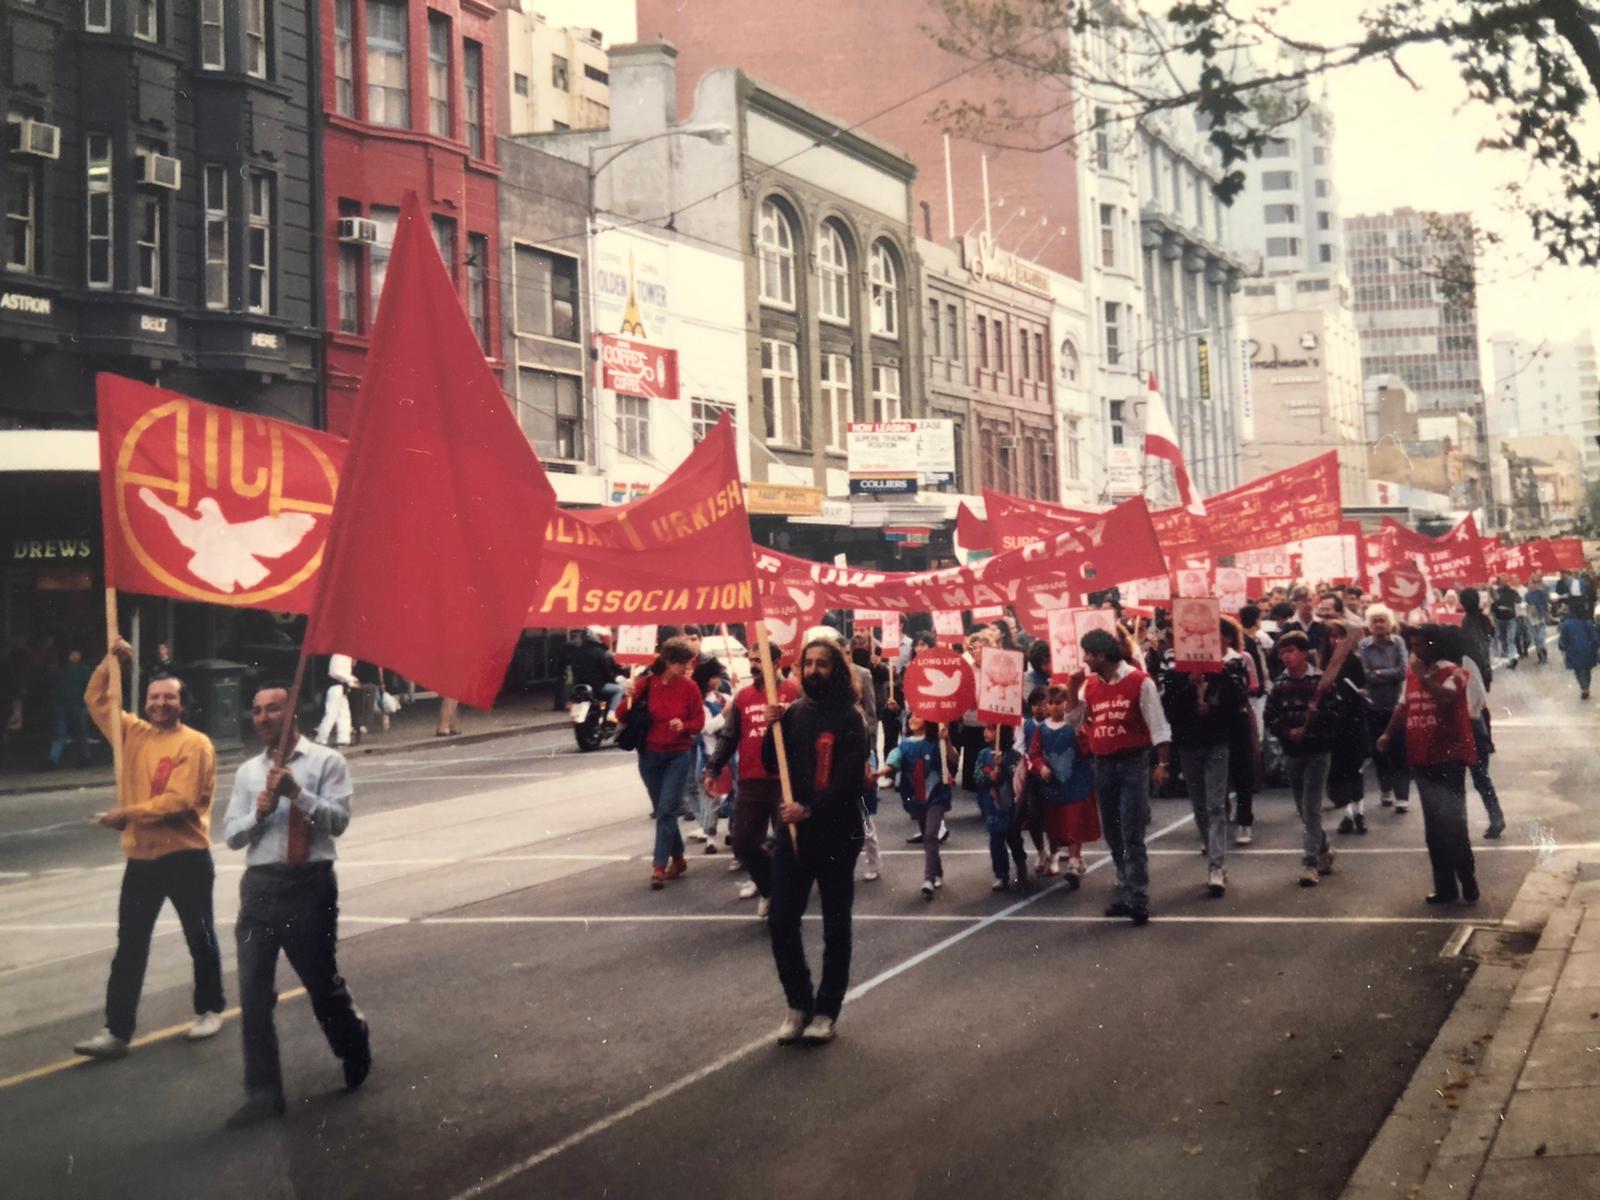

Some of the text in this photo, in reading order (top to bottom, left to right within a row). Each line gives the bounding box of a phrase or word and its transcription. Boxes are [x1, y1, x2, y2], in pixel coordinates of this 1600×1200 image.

[1, 293, 50, 314] ASTRON
[141, 314, 167, 332] BELT
[852, 423, 873, 433] NOW
[860, 480, 908, 489] COLLIERS
[616, 480, 743, 552] TURKISH
[14, 540, 91, 558] DREWS
[540, 559, 754, 614] ASSOCIATION
[1049, 580, 1068, 589] LIVE
[917, 656, 962, 666] LONG LIVE
[919, 701, 957, 710] MAY DAY
[988, 703, 1015, 713] ATCA
[1092, 699, 1131, 712] LONG LIVE
[752, 714, 765, 723] MA
[1108, 711, 1127, 721] DAY
[1406, 715, 1438, 730] ATCA
[749, 726, 767, 738] AT
[1093, 724, 1127, 739] ATCA
